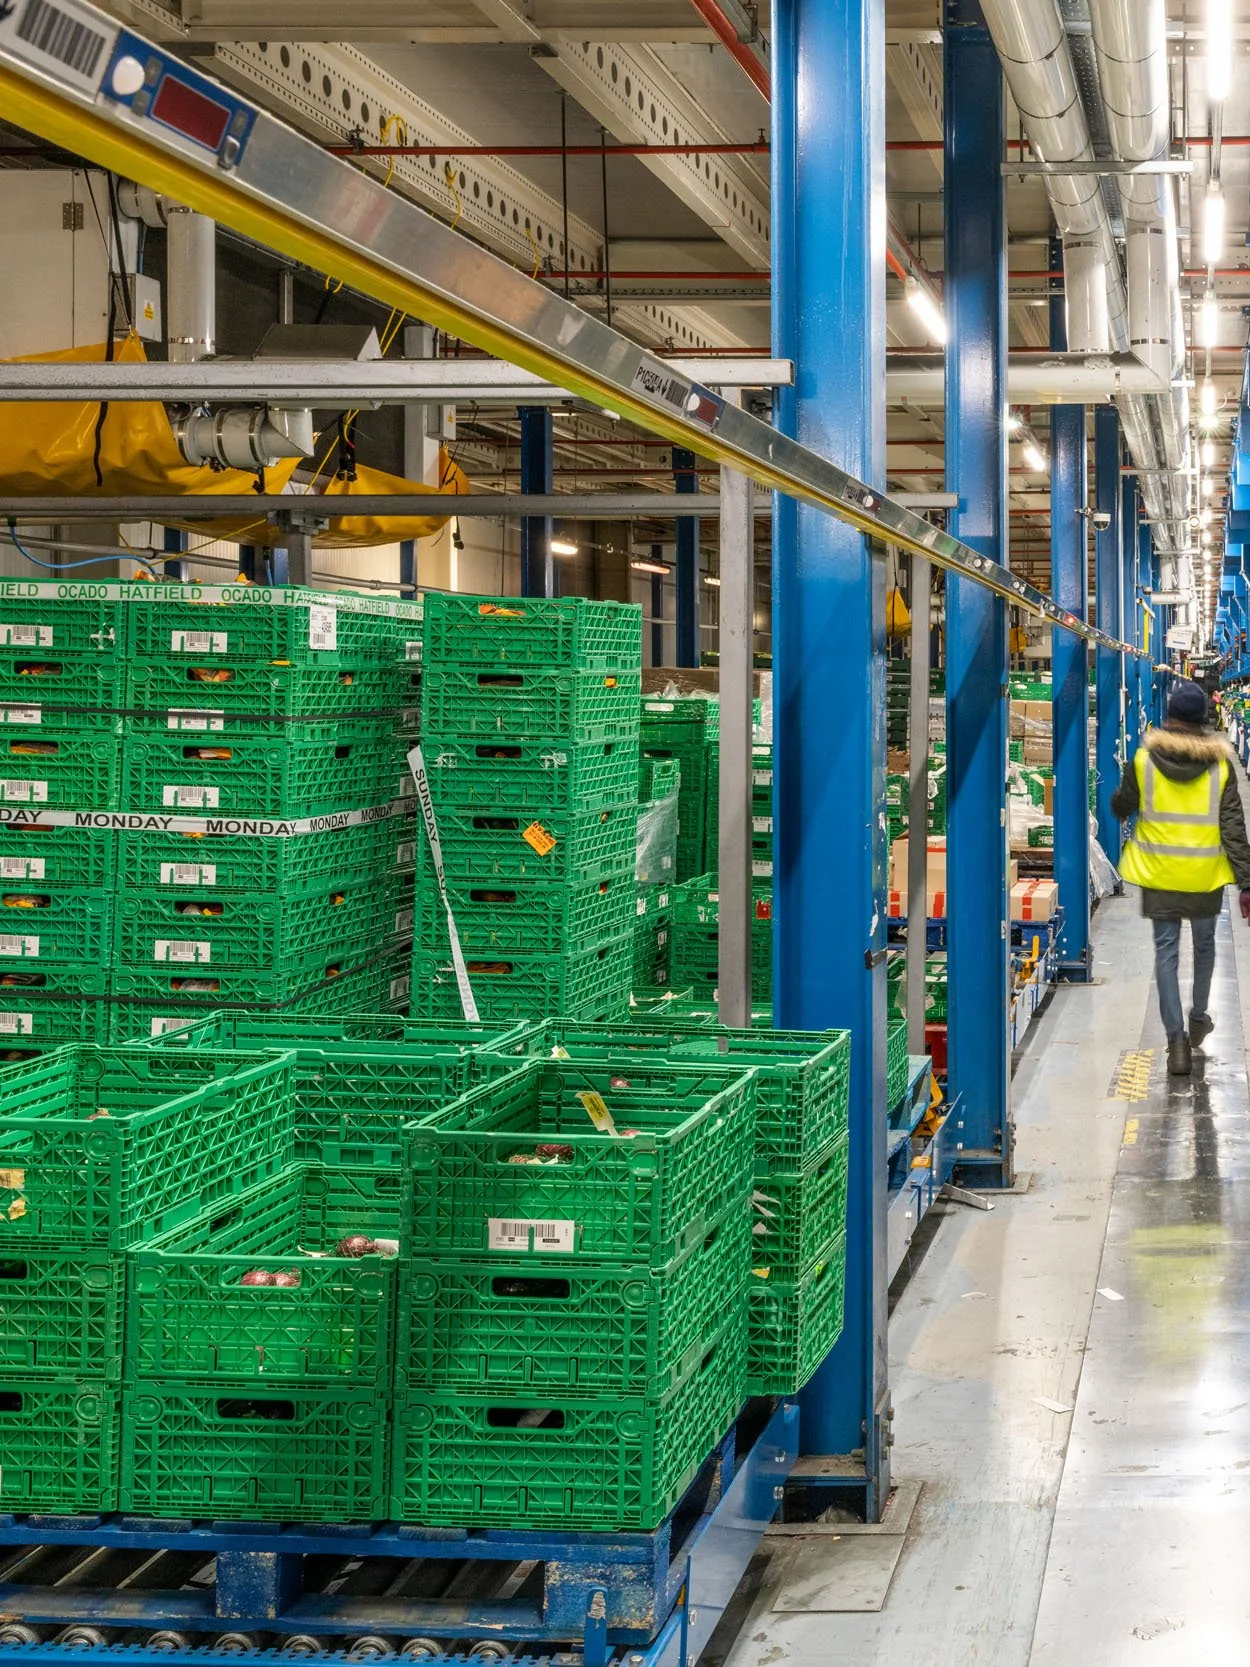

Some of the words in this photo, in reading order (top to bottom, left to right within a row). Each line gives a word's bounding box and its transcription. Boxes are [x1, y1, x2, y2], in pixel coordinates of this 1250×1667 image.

[57, 585, 109, 599] OCADO
[119, 585, 203, 601] HATFIELD
[221, 588, 272, 604] OCADO
[359, 598, 390, 614] HATFIELD
[0, 808, 42, 823] DAY
[75, 812, 173, 829] MONDAY
[206, 819, 297, 836] MONDAY
[309, 814, 350, 832] MONDAY
[361, 803, 394, 821] MONDAY
[414, 767, 438, 843] SUNDAY
